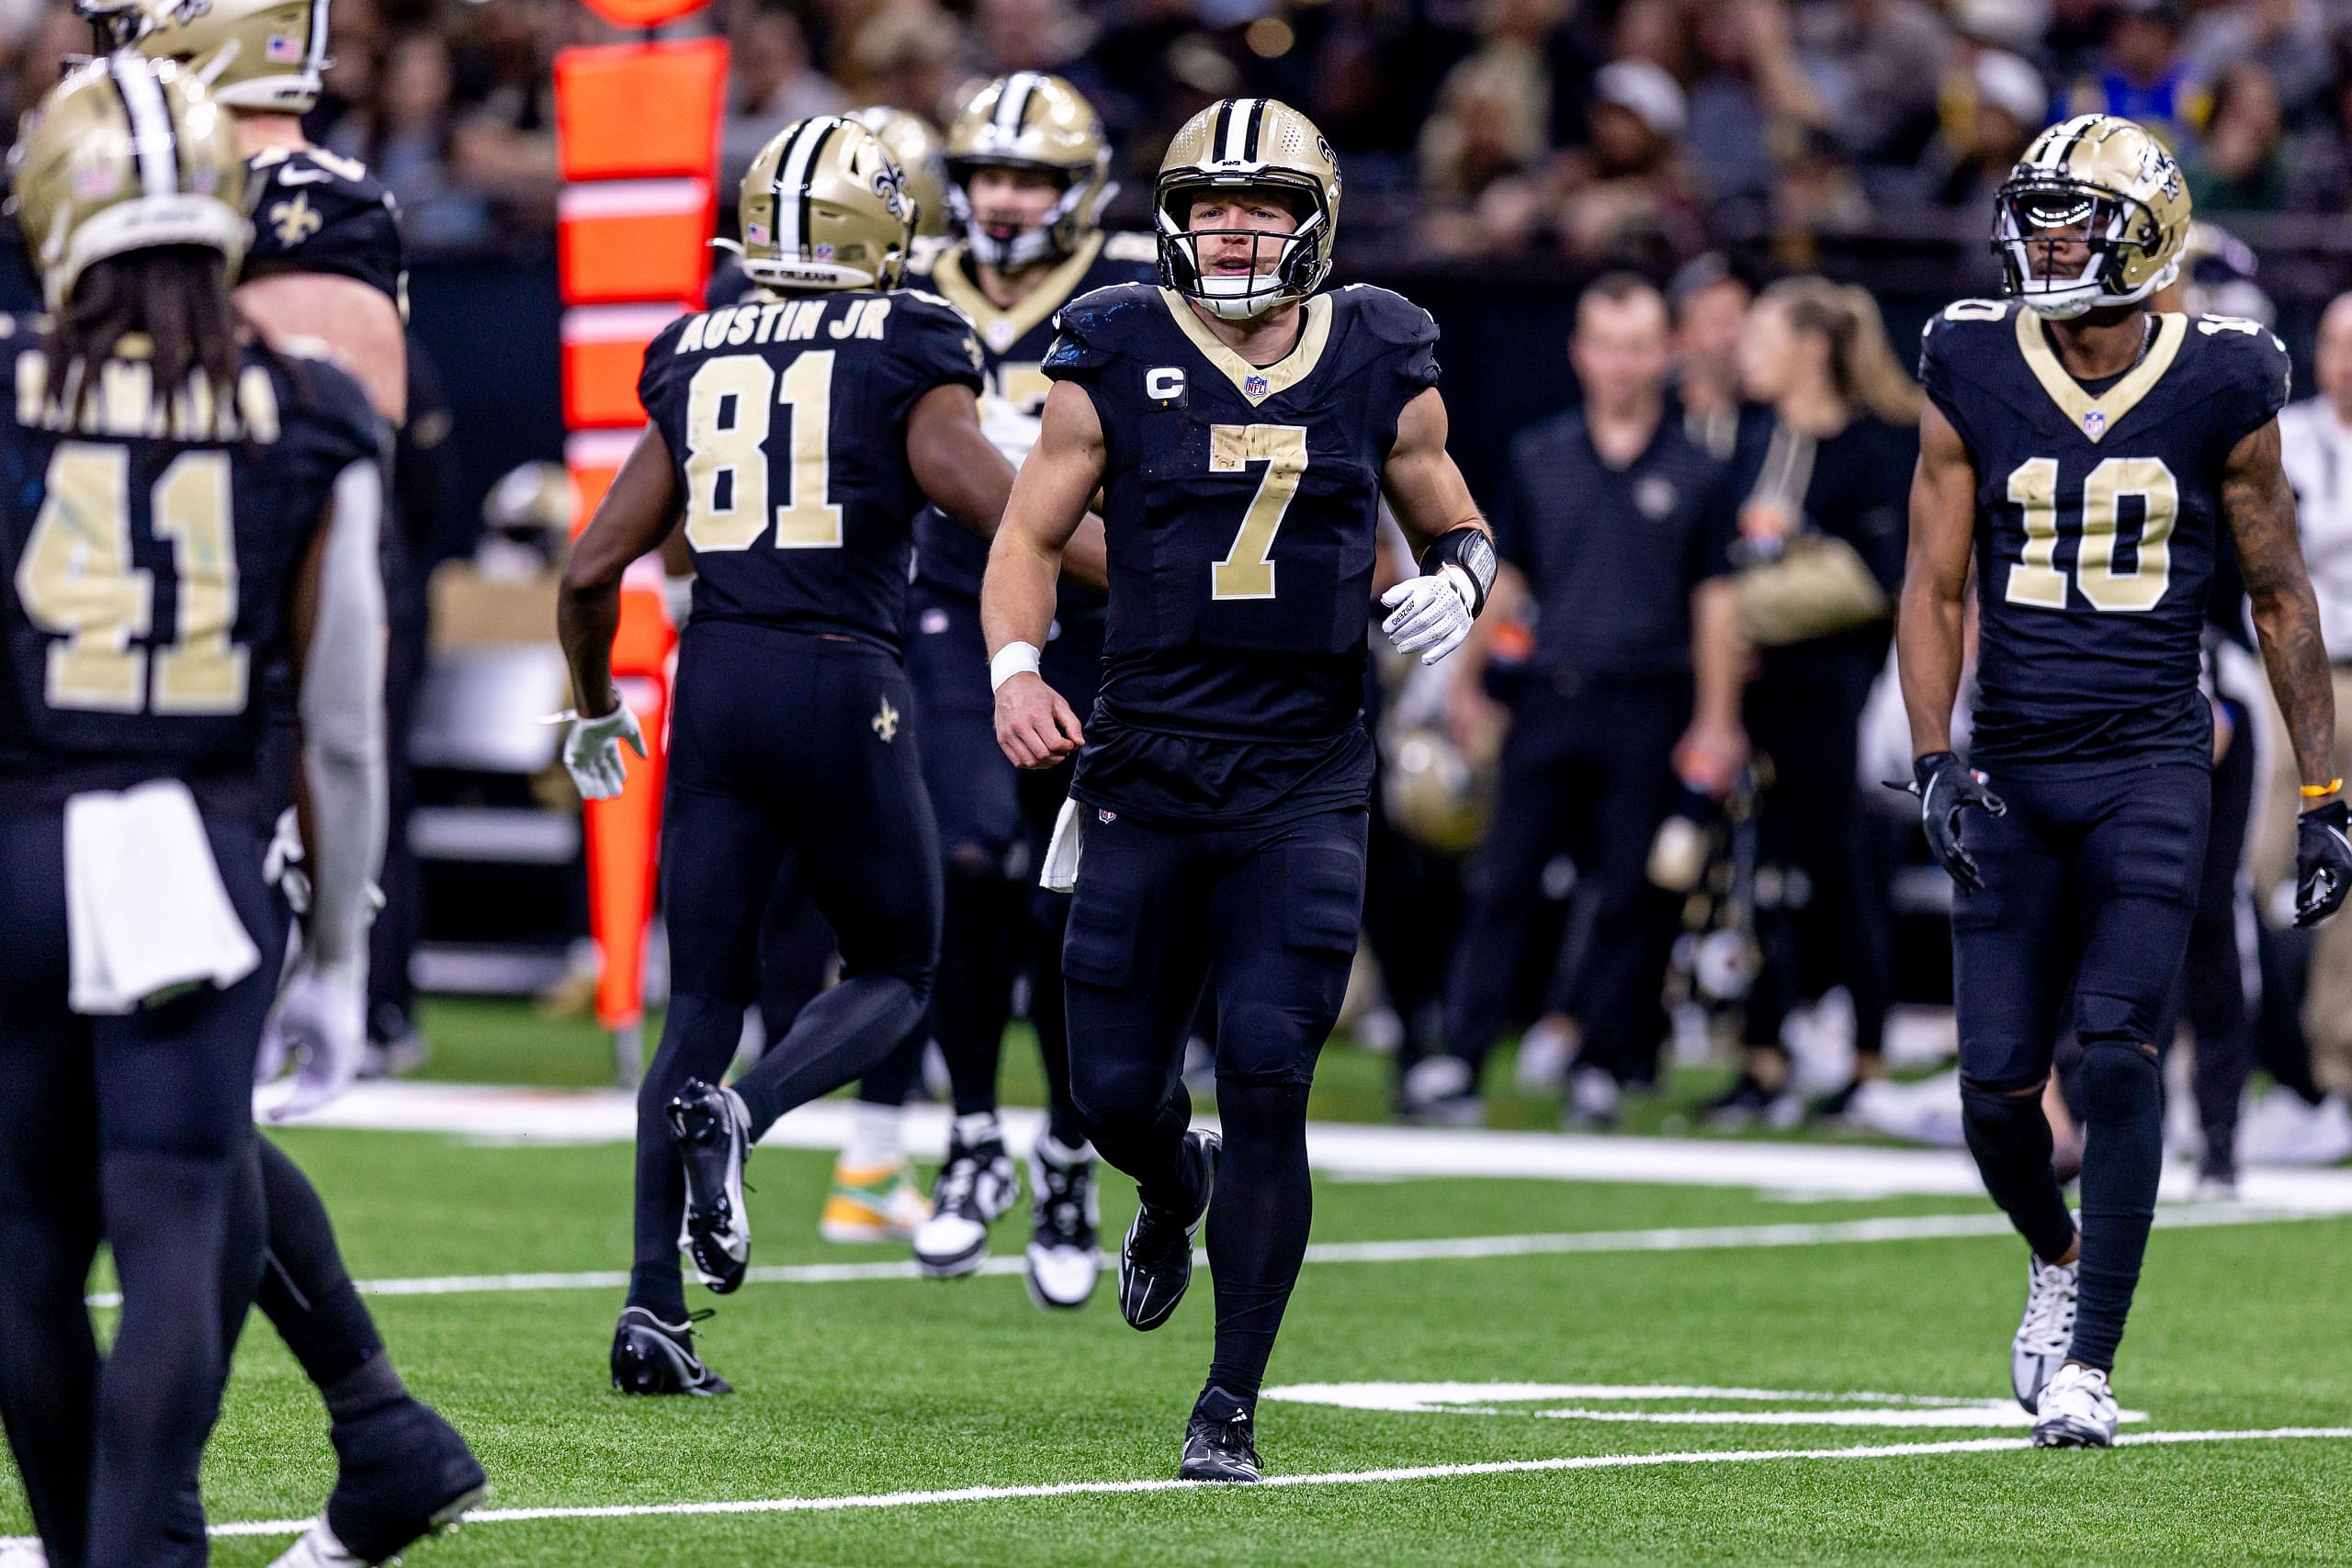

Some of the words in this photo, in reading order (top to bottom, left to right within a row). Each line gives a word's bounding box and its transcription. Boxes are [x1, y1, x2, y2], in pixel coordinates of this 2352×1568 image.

[674, 300, 828, 355] AUSTIN
[828, 298, 892, 341] JR
[1146, 367, 1184, 400] C
[684, 349, 843, 553] 81
[1209, 423, 1309, 601] 7
[15, 441, 251, 716] 41
[2005, 457, 2179, 612] 10
[1391, 599, 1416, 626] ADIZERO
